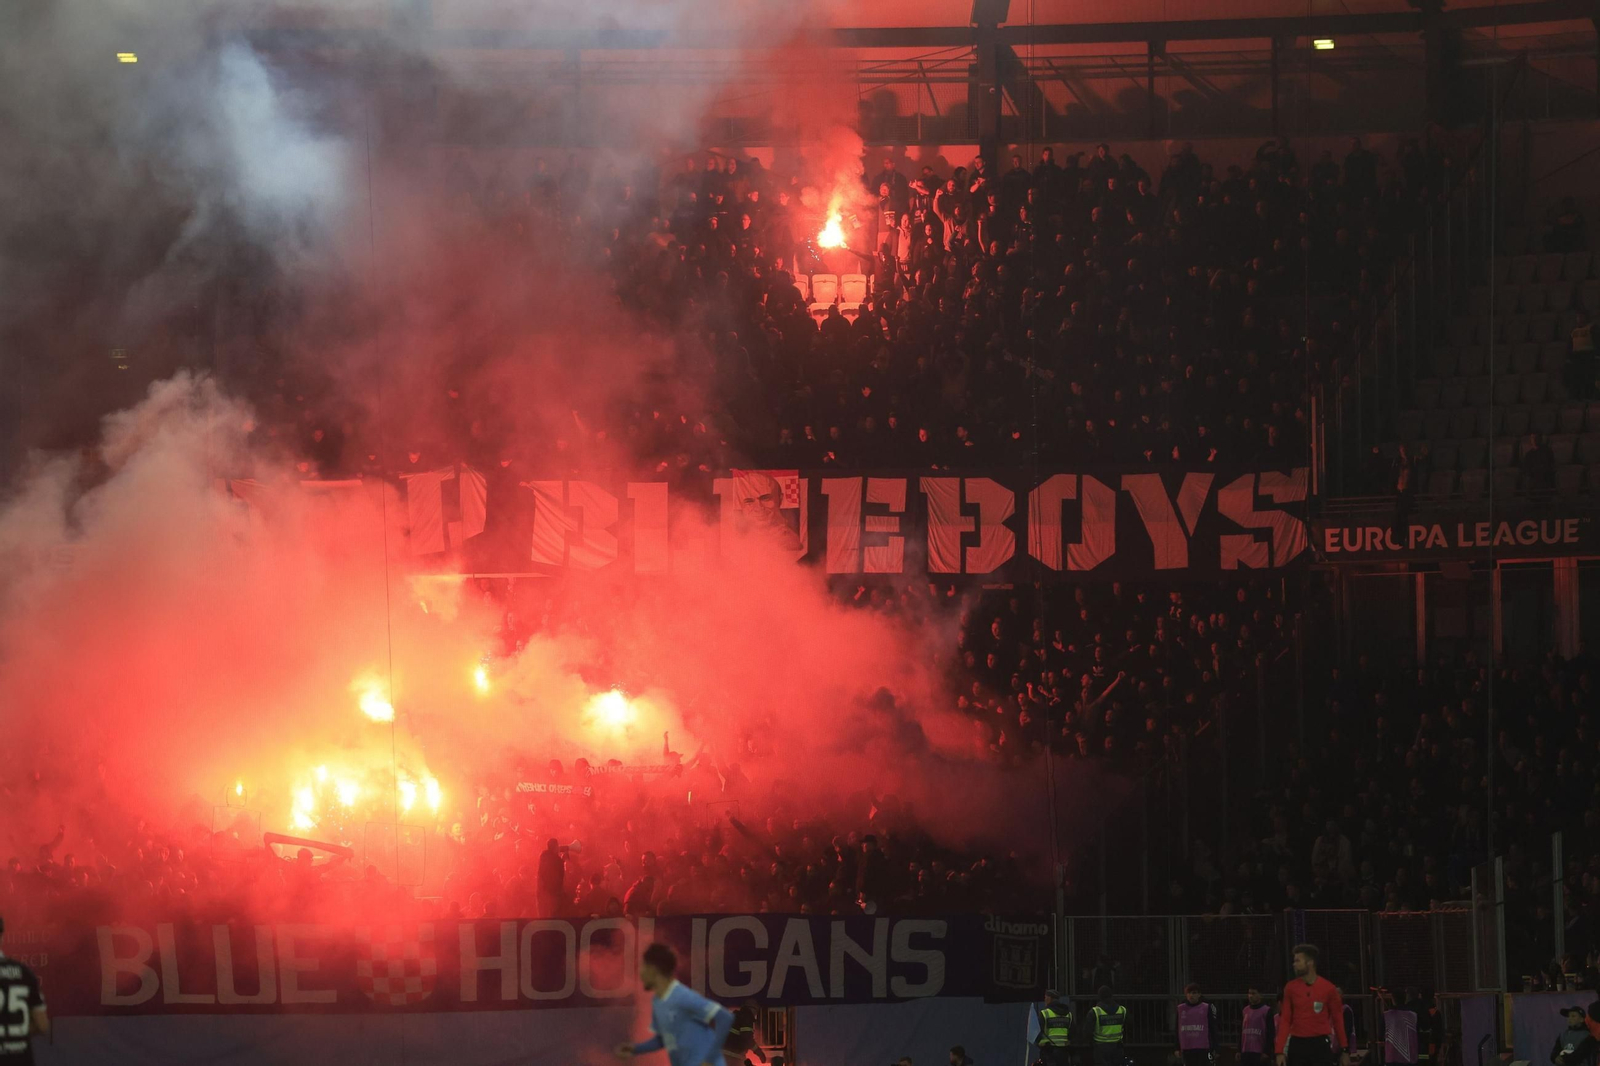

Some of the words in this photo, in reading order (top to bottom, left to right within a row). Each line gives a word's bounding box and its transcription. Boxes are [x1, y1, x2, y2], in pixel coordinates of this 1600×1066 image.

[984, 912, 1049, 936] dinamo
[96, 921, 338, 1006] BLUE
[0, 984, 30, 1037] 5
